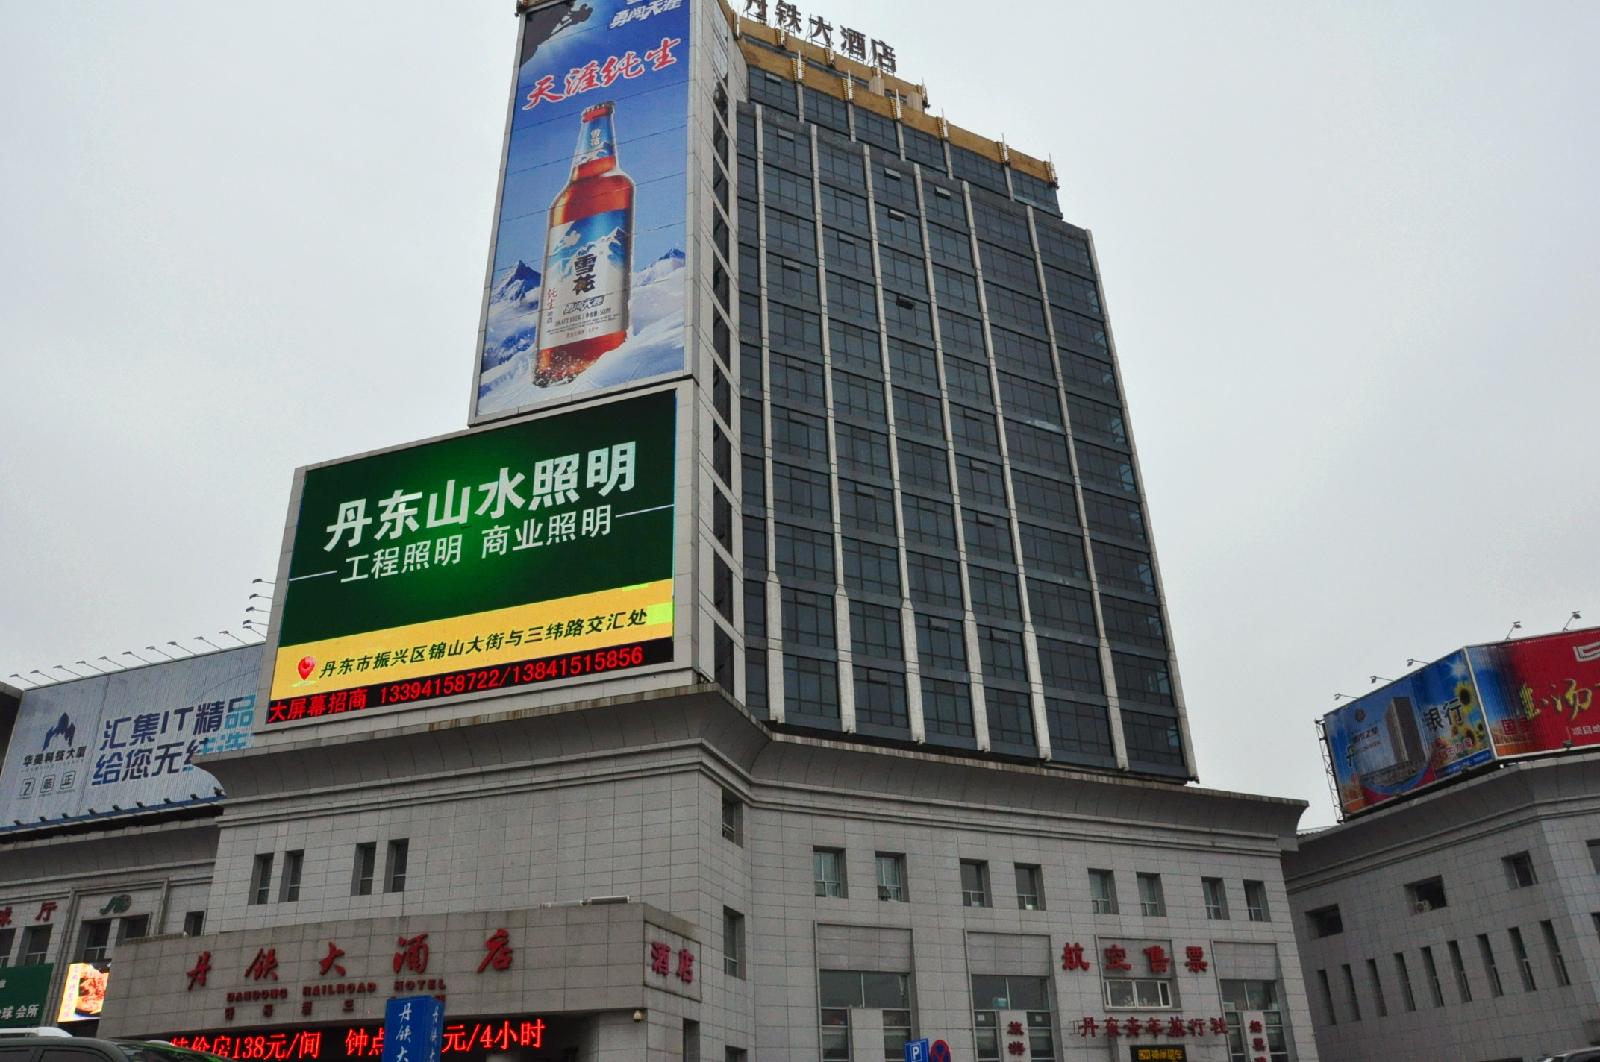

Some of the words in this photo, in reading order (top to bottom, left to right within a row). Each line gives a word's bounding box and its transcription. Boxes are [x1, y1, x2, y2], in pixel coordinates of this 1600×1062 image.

[521, 37, 681, 110] 天涯纯生
[573, 253, 598, 296] 雪花
[324, 440, 637, 552] 丹东山水照明
[340, 534, 461, 584] 工程照明
[481, 504, 612, 559] 商业照明
[319, 607, 647, 679] 丹东市振兴区锦山大街与三纬路交汇处
[268, 687, 368, 723] 大屏幕招商
[379, 645, 644, 705] 13394158722/13841515856
[100, 694, 257, 750] 汇集IT精品
[187, 928, 514, 993] 丹铁大酒店
[393, 978, 446, 992] HOTEL
[651, 942, 694, 984] 酒店
[1061, 942, 1209, 974] 航空售票
